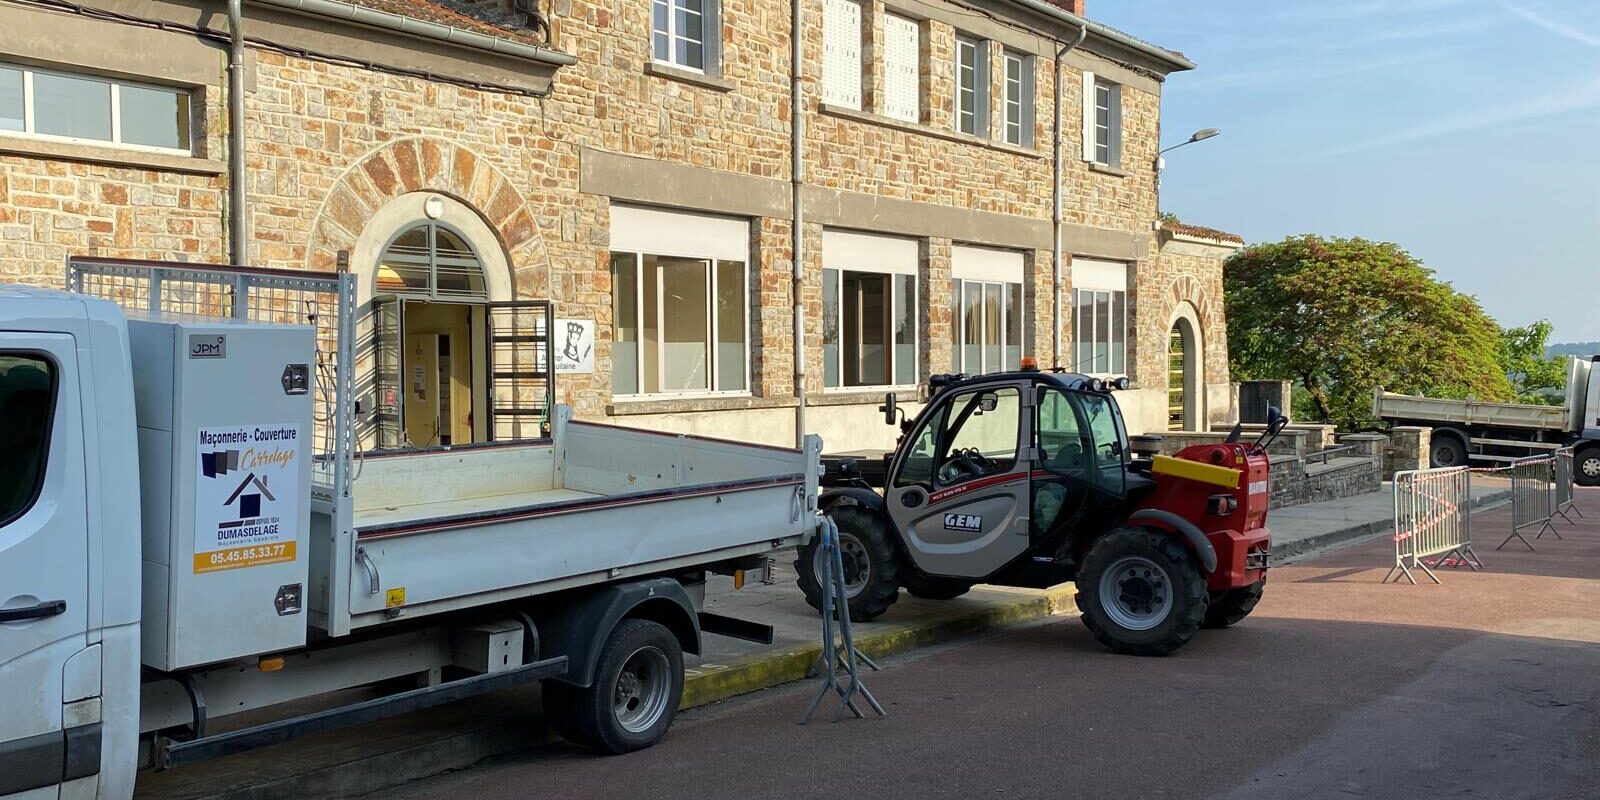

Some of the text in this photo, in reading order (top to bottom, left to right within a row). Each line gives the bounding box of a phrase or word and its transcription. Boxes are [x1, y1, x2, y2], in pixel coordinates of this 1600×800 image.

[193, 344, 220, 354] JPM
[200, 429, 247, 448] Maçonnerie
[254, 427, 297, 442] Couverture
[241, 445, 295, 471] Carrelage
[945, 514, 981, 528] GEM
[217, 524, 279, 540] DUMASDELAGE
[210, 545, 286, 564] 05.45.85.33.77
